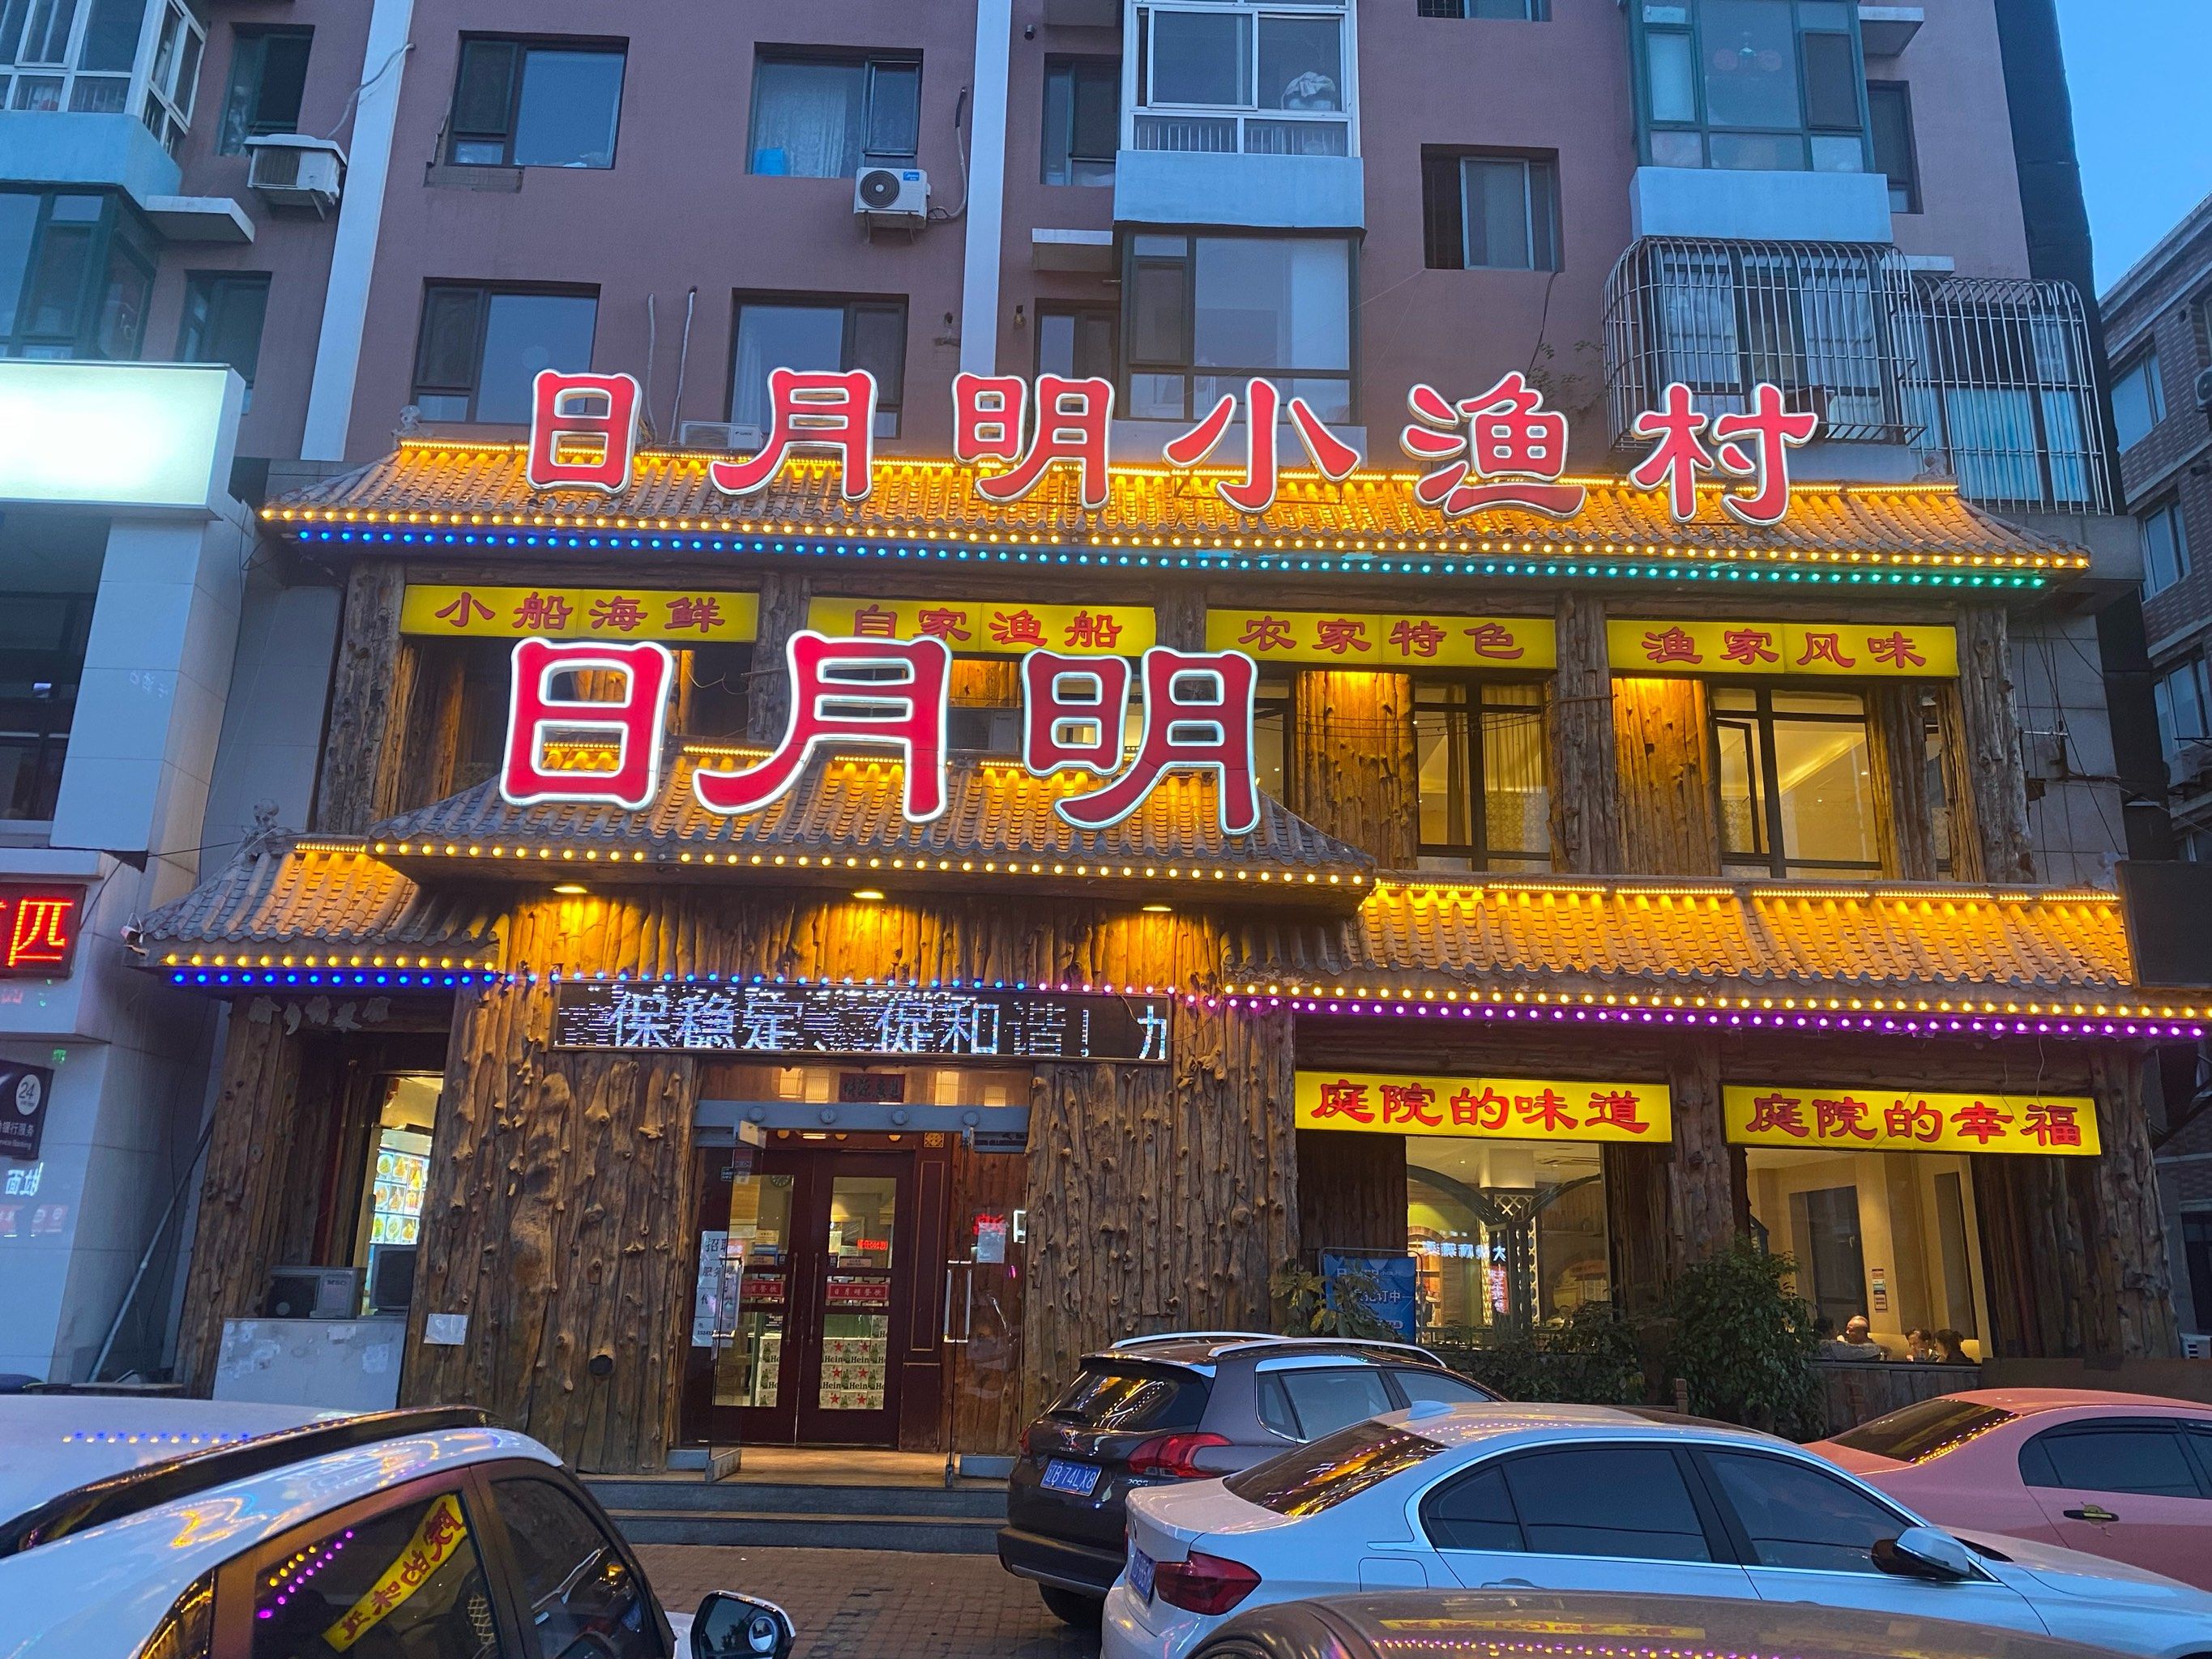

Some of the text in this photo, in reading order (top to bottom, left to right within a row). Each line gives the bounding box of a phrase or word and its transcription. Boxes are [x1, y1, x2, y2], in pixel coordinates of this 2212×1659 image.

[525, 367, 1819, 527] 日月明小渔村
[434, 591, 725, 633] 小船海鲜
[853, 604, 1123, 648] 自家渔船
[1238, 616, 1525, 660] 农家特色
[1641, 628, 1927, 668] 渔家风味
[499, 630, 1260, 838] 日月明
[0, 899, 74, 966] 匹
[19, 1081, 35, 1099] 24
[1310, 1079, 1650, 1133] 庭院的味道
[1745, 1094, 2082, 1146] 庭院的幸福
